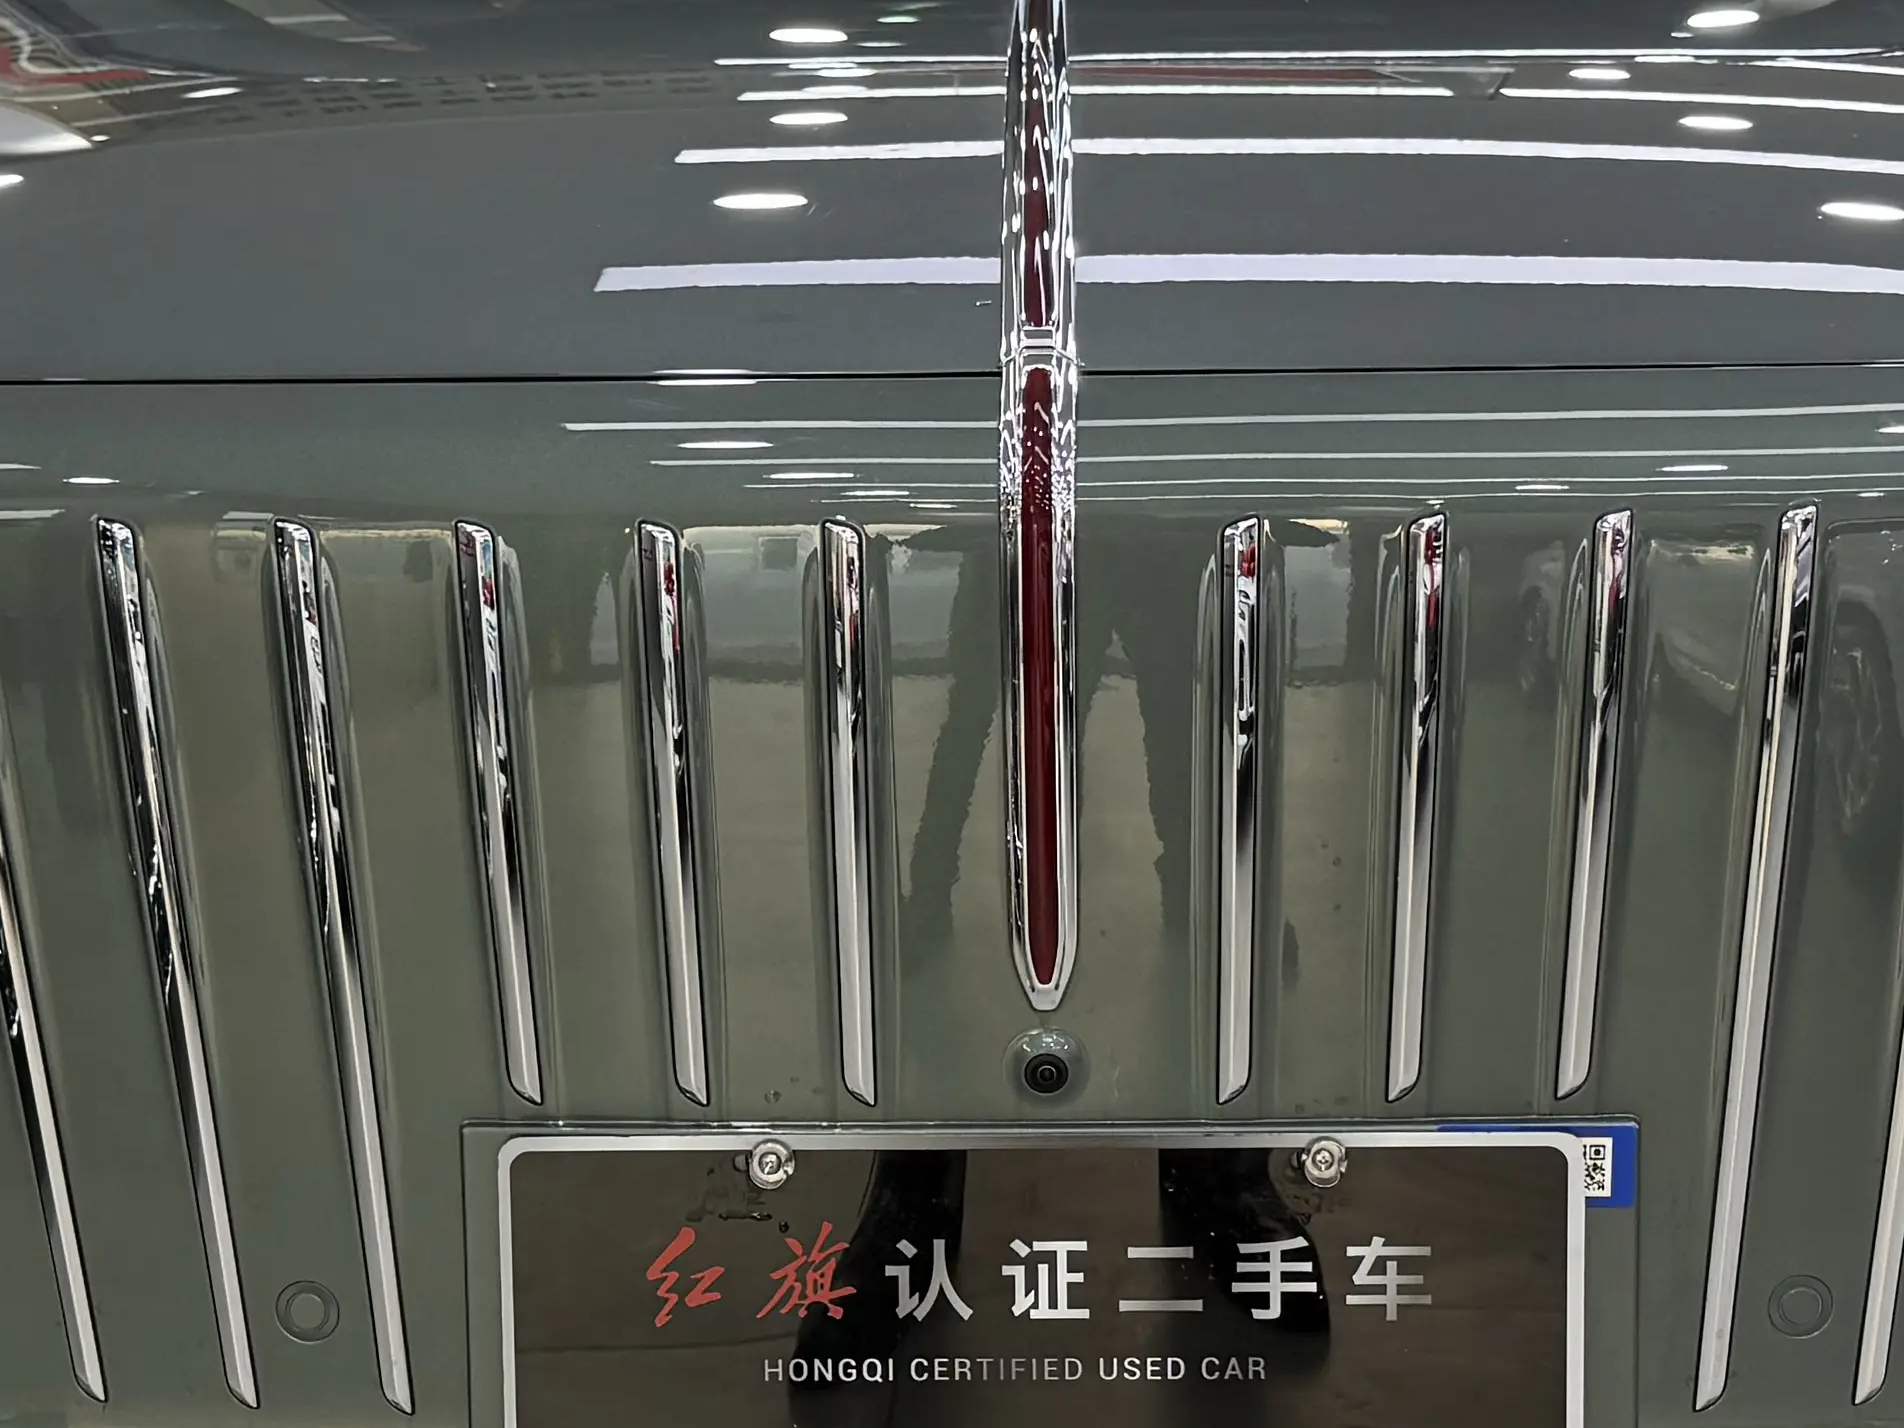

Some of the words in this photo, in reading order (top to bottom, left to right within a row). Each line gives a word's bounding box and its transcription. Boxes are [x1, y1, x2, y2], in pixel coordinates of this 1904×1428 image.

[764, 1358, 897, 1383] HONGQI
[910, 1357, 1083, 1381] CERTIFIED
[1099, 1357, 1187, 1381] USED
[1201, 1356, 1267, 1380] CAR
